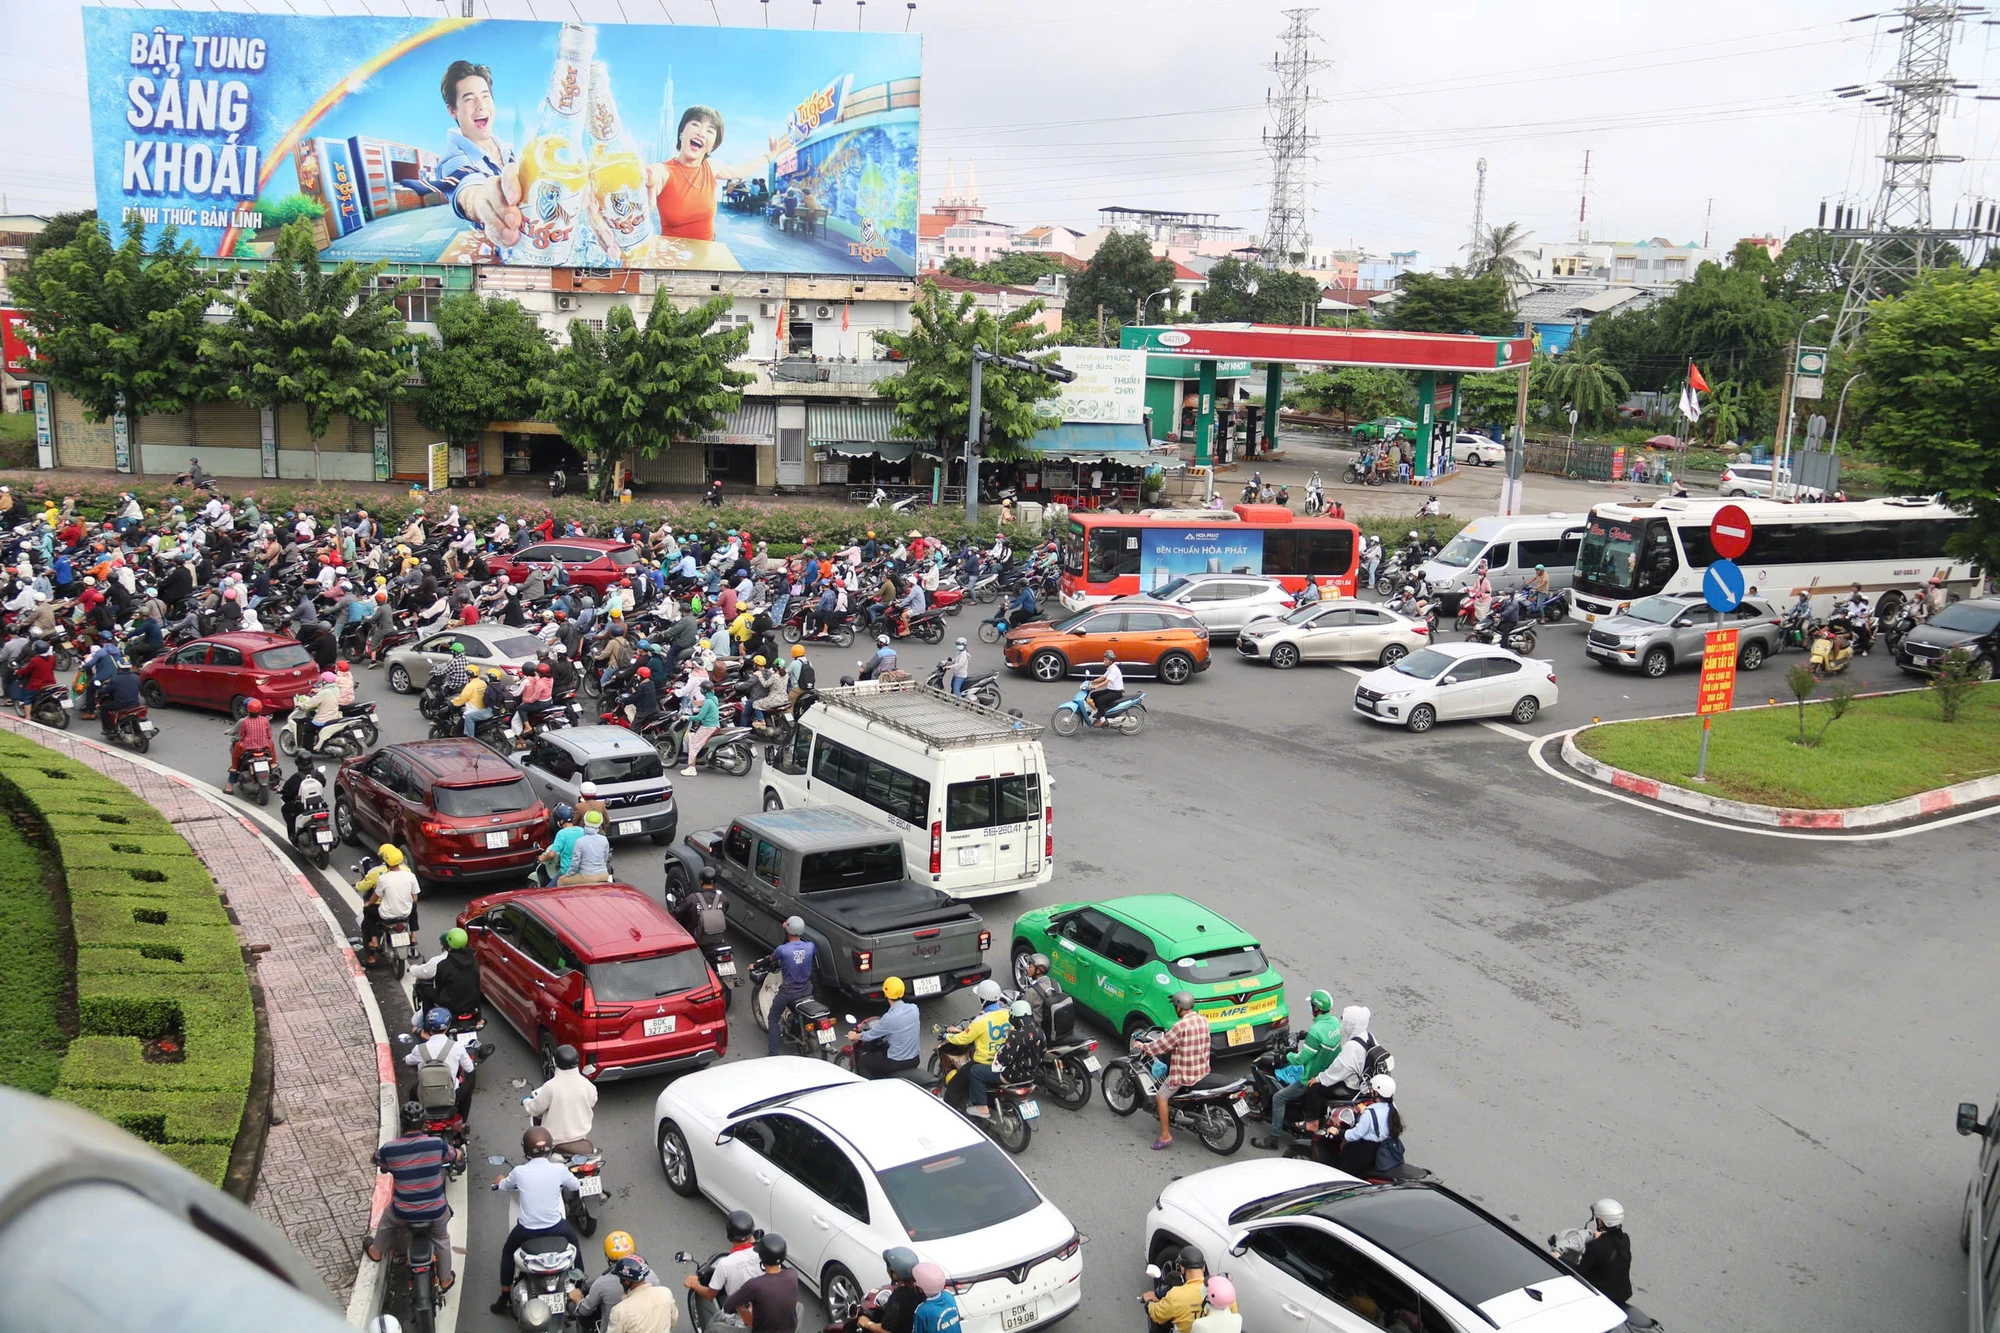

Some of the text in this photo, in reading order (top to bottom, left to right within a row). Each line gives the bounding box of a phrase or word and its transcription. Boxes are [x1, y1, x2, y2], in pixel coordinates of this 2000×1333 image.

[131, 26, 266, 75] BẬT TUNG
[558, 64, 581, 110] Tiger
[127, 63, 249, 132] SẢNG
[796, 86, 835, 129] Tiger
[123, 134, 257, 195] KHOÁI
[334, 161, 355, 217] Tiger
[161, 205, 198, 226] THỨC
[200, 206, 228, 228] BẢN
[231, 207, 262, 229] LĨNH
[603, 213, 645, 235] Tiger
[519, 215, 573, 249] Tiger
[847, 242, 889, 263] Tiger
[1163, 335, 1185, 343] SATRA
[1114, 386, 1136, 395] CHAY
[1156, 544, 1171, 554] BỀN
[1201, 545, 1222, 554] HÒA
[1224, 544, 1248, 555] PHÁT
[1704, 651, 1735, 670] CẤM TẤT CẢ
[983, 824, 1021, 837] 51B-280.41
[912, 943, 941, 957] Jeep
[920, 978, 932, 986] 51K
[1220, 1006, 1248, 1018] MPE
[652, 1019, 666, 1027] 60K
[1011, 1303, 1027, 1316] 60K
[1007, 1311, 1035, 1328] 019.08
